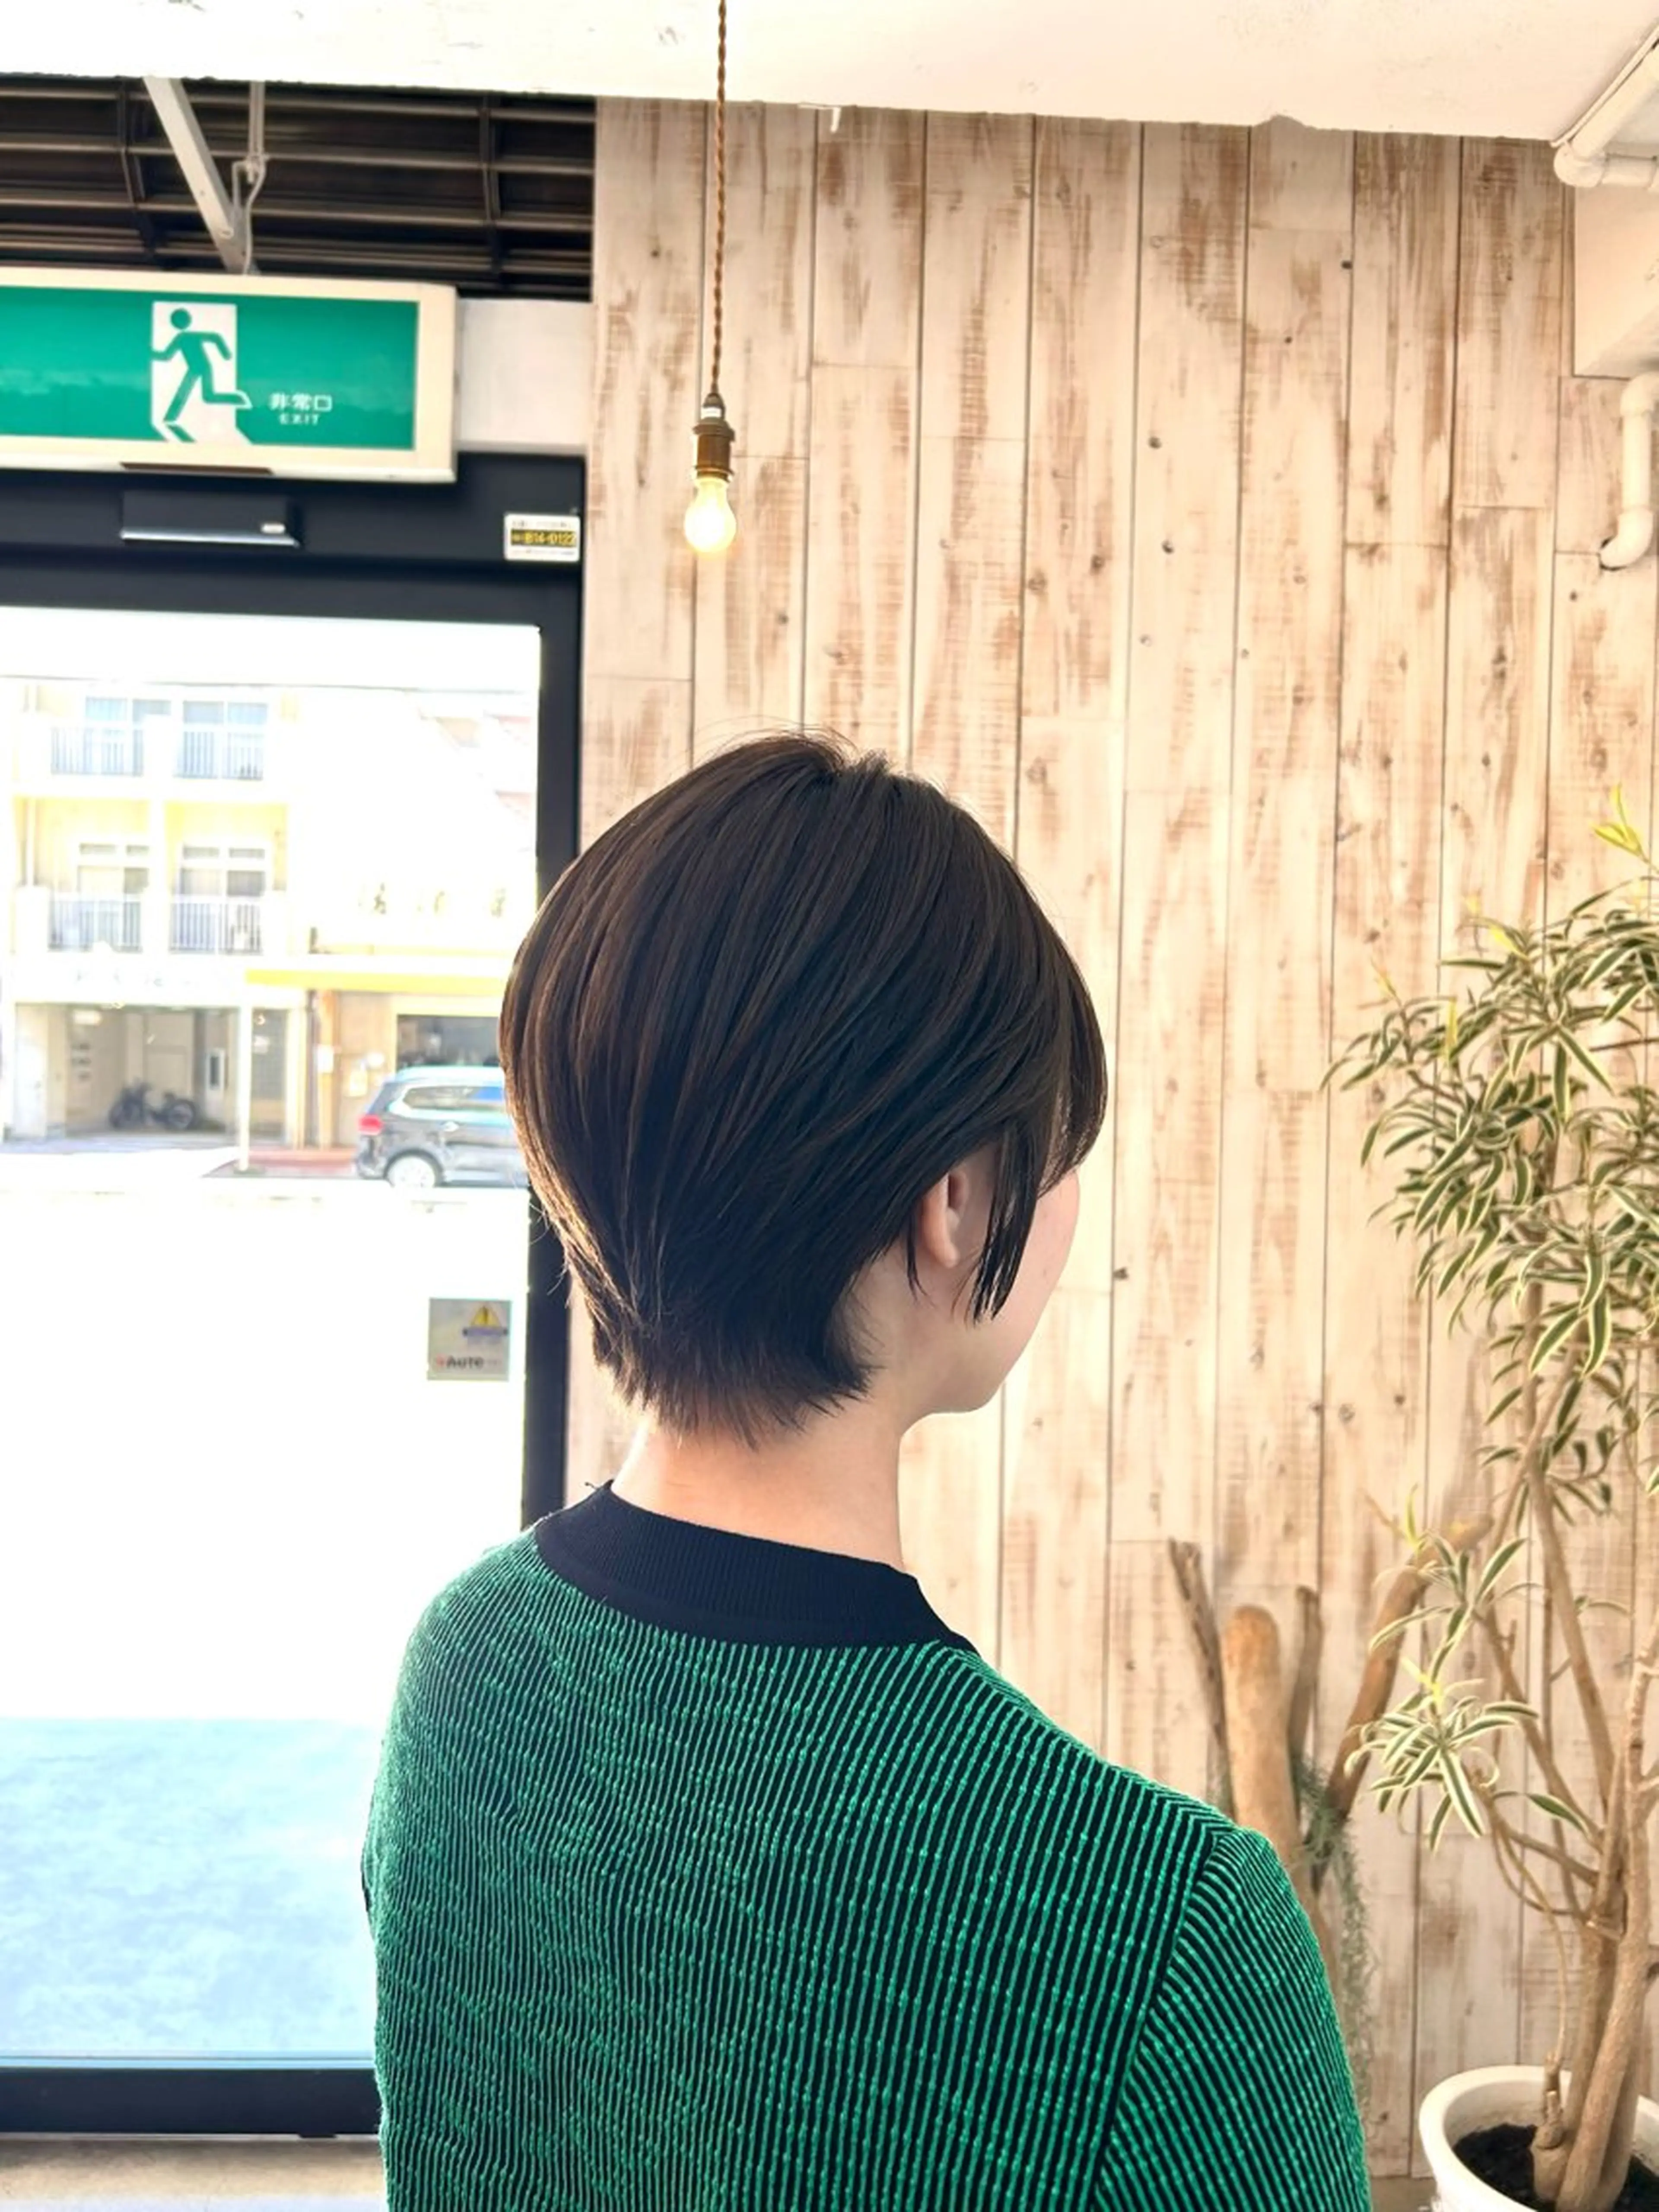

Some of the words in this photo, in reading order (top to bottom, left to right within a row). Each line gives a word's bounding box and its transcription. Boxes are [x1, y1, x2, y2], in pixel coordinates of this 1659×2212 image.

[270, 393, 332, 411] 非常口
[280, 413, 319, 425] EXIT
